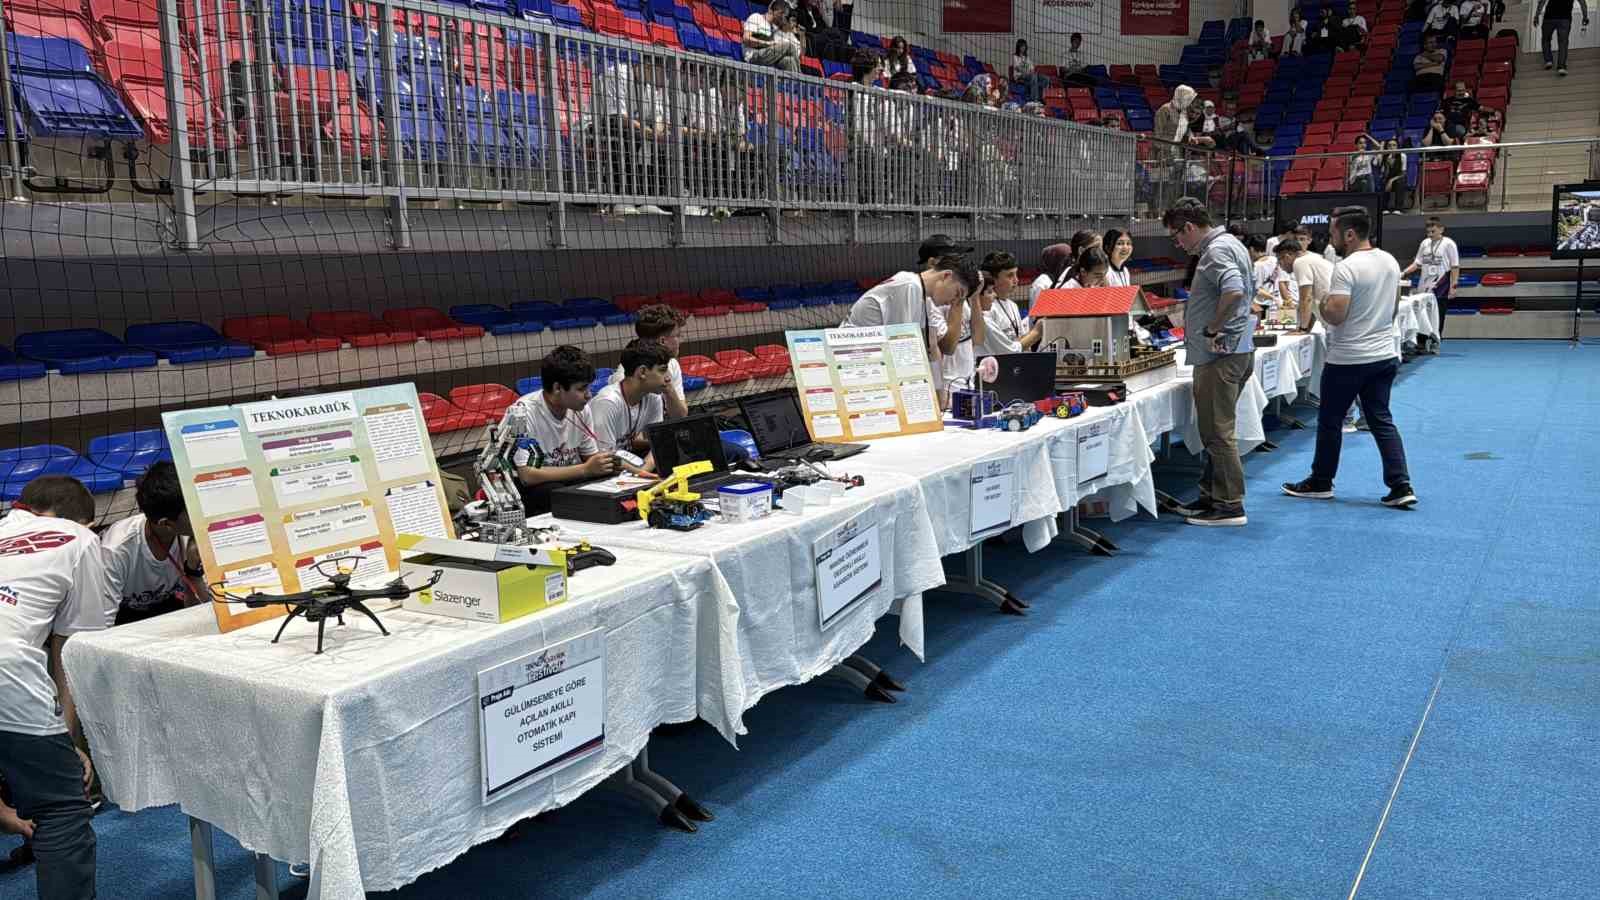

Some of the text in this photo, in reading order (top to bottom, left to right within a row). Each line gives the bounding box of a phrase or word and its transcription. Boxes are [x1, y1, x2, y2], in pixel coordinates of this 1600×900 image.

[252, 402, 351, 423] TEKNOKARABÜK
[504, 677, 587, 718] GÜLÜMSEMEYE GÖRE
[520, 697, 574, 727] AÇILAN AKILLI
[517, 711, 577, 743] OTOMATİK KAPI
[532, 730, 564, 752] SİSTEMİ
